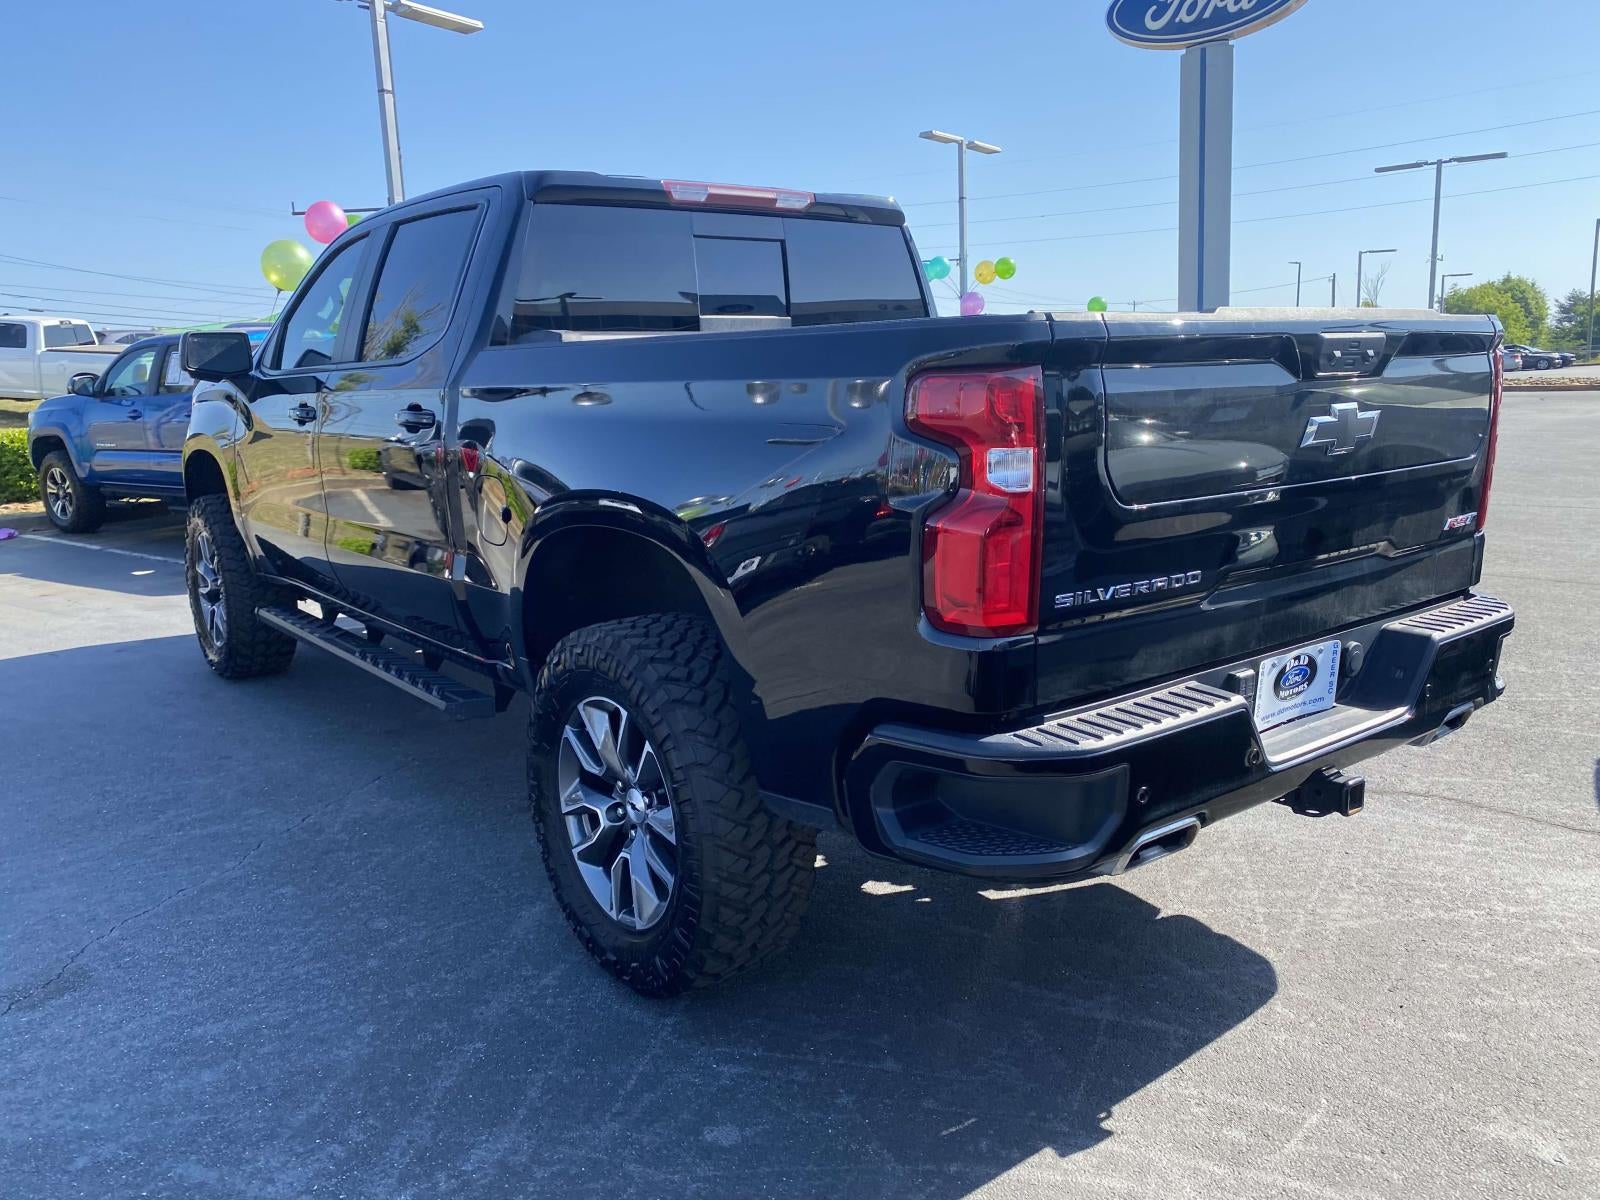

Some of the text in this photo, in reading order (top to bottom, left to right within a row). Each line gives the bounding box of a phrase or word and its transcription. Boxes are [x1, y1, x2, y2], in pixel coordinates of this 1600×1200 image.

[1443, 511, 1478, 531] RST
[1054, 570, 1202, 609] SILVERADO
[1285, 655, 1309, 673] D&D
[1285, 669, 1304, 686] Ford
[1279, 681, 1309, 699] MOTORS
[1261, 697, 1325, 722] www.ddmotors.com
